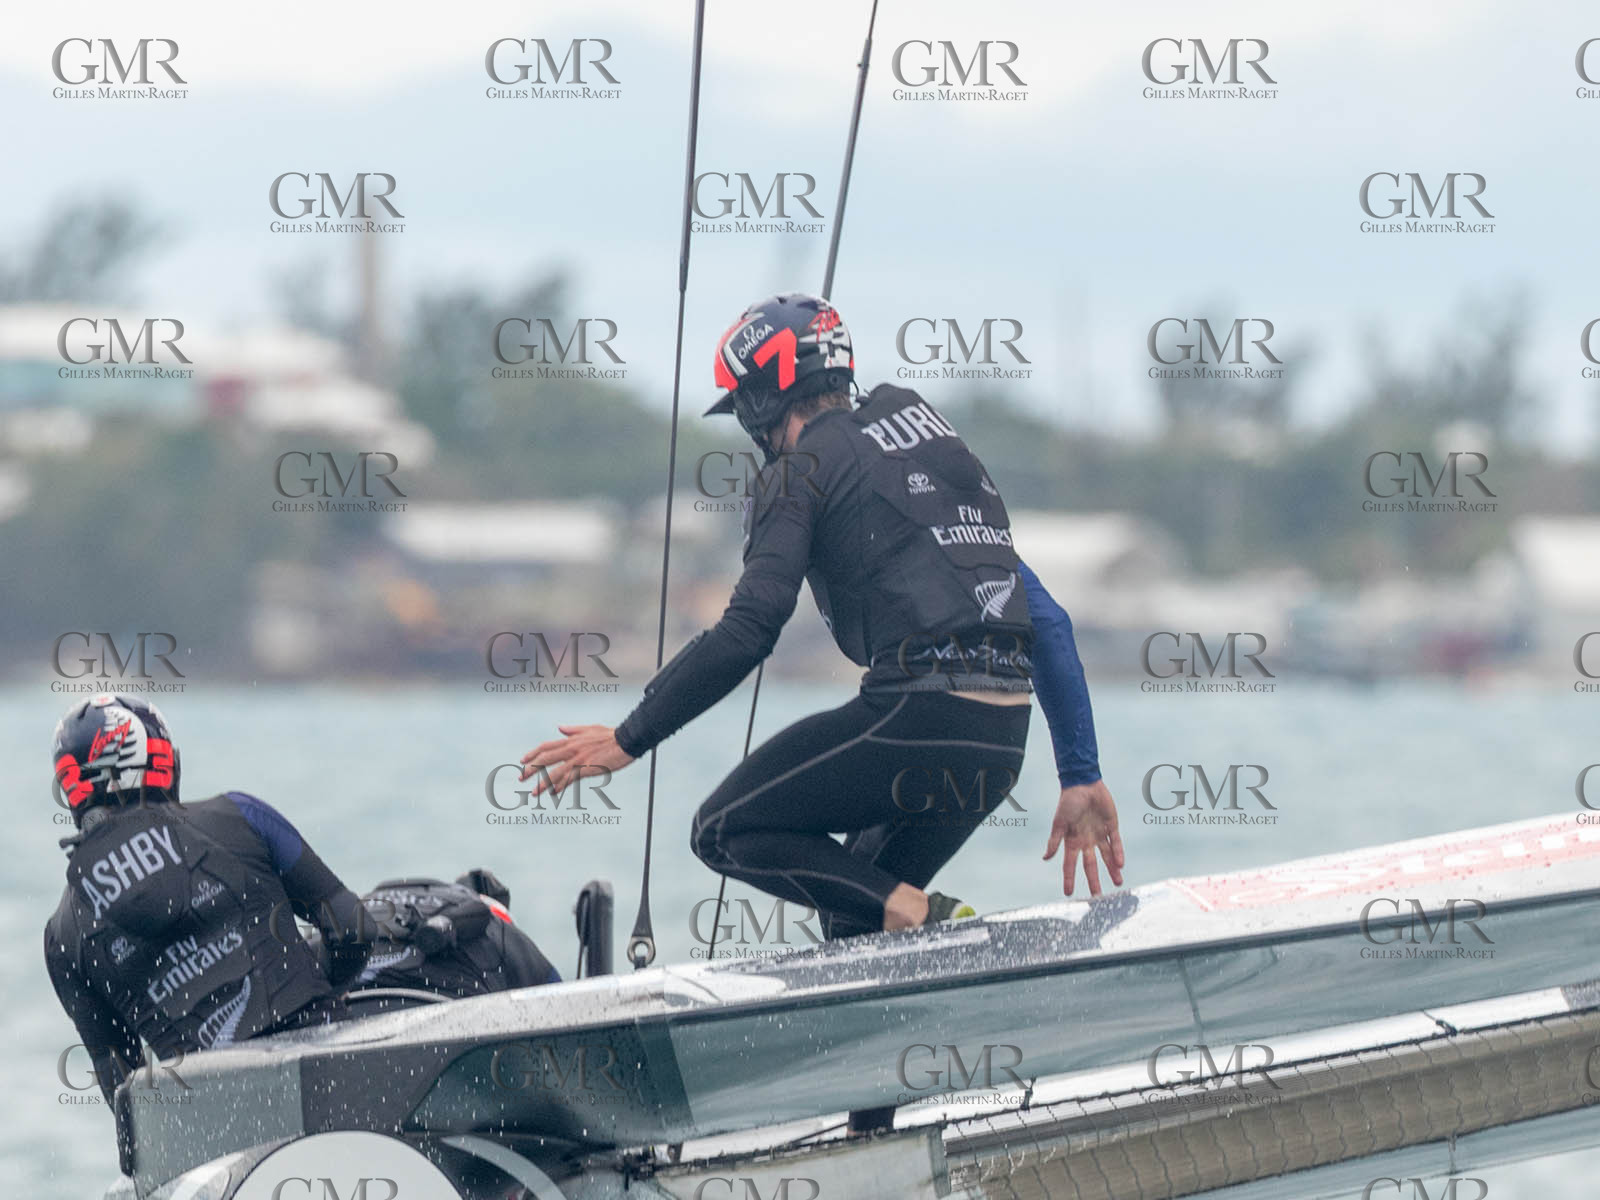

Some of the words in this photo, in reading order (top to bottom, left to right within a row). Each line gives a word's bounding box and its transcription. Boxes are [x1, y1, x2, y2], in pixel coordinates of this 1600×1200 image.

[738, 323, 774, 360] OMEGA
[908, 484, 936, 495] TOYOTA
[957, 504, 984, 525] Fly
[929, 523, 1013, 548] Emirates
[81, 825, 182, 920] ASHBY
[165, 935, 199, 966] Fly
[147, 929, 244, 1005] Emirates
